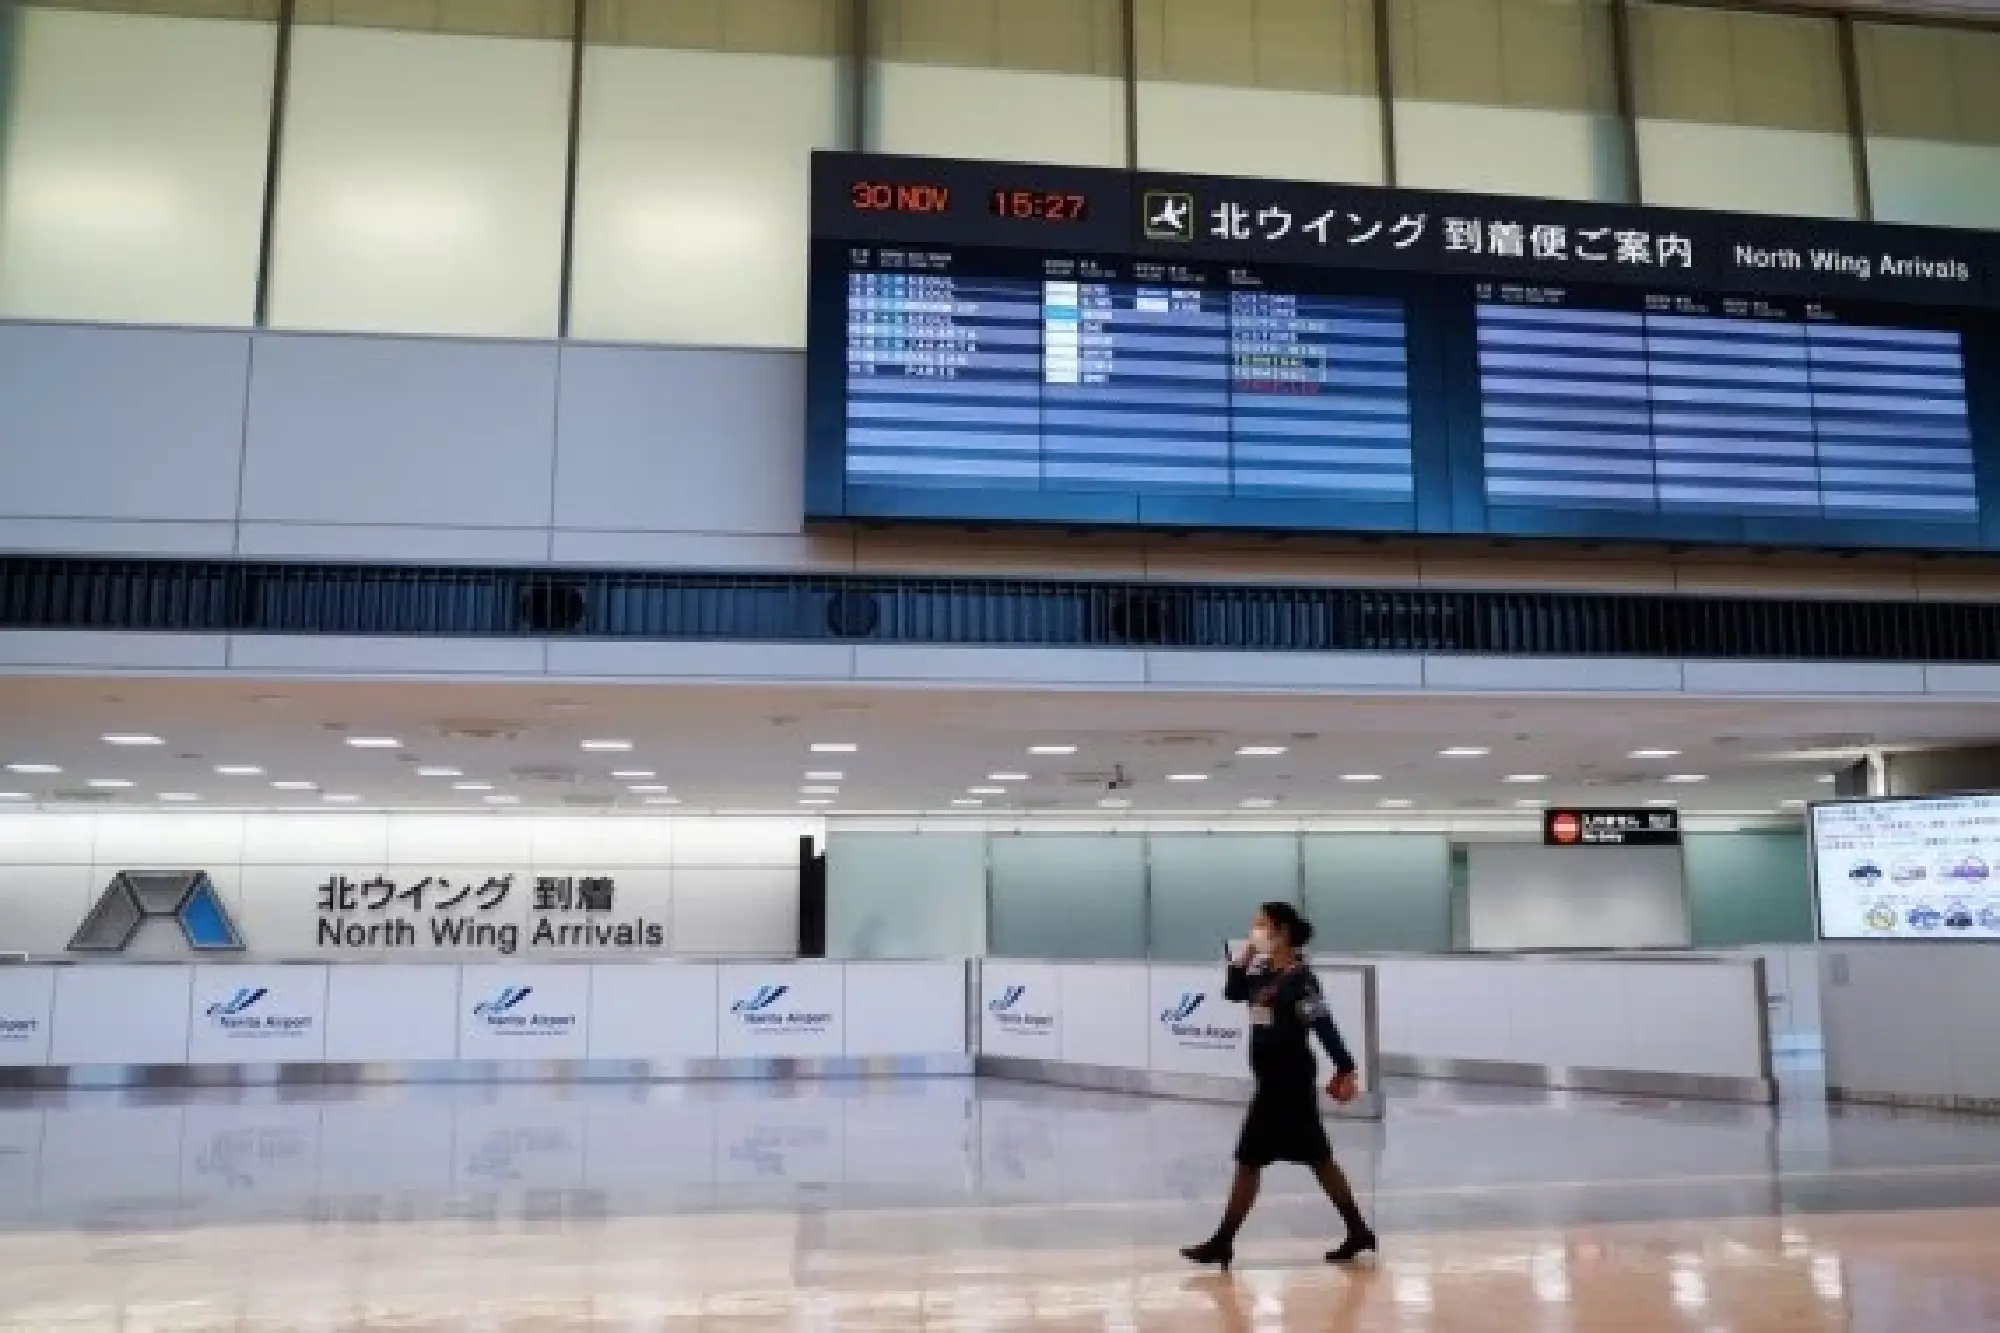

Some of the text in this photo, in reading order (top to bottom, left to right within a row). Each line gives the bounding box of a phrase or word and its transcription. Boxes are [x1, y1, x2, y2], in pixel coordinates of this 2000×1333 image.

[852, 181, 948, 211] 30 NOV
[1209, 202, 1692, 268] 北ウイング 到着便ご案内
[1733, 243, 1970, 281] North Wing Arrivals
[317, 873, 616, 912] 北ウイング 到着
[317, 916, 664, 954] North Wing Arrivals
